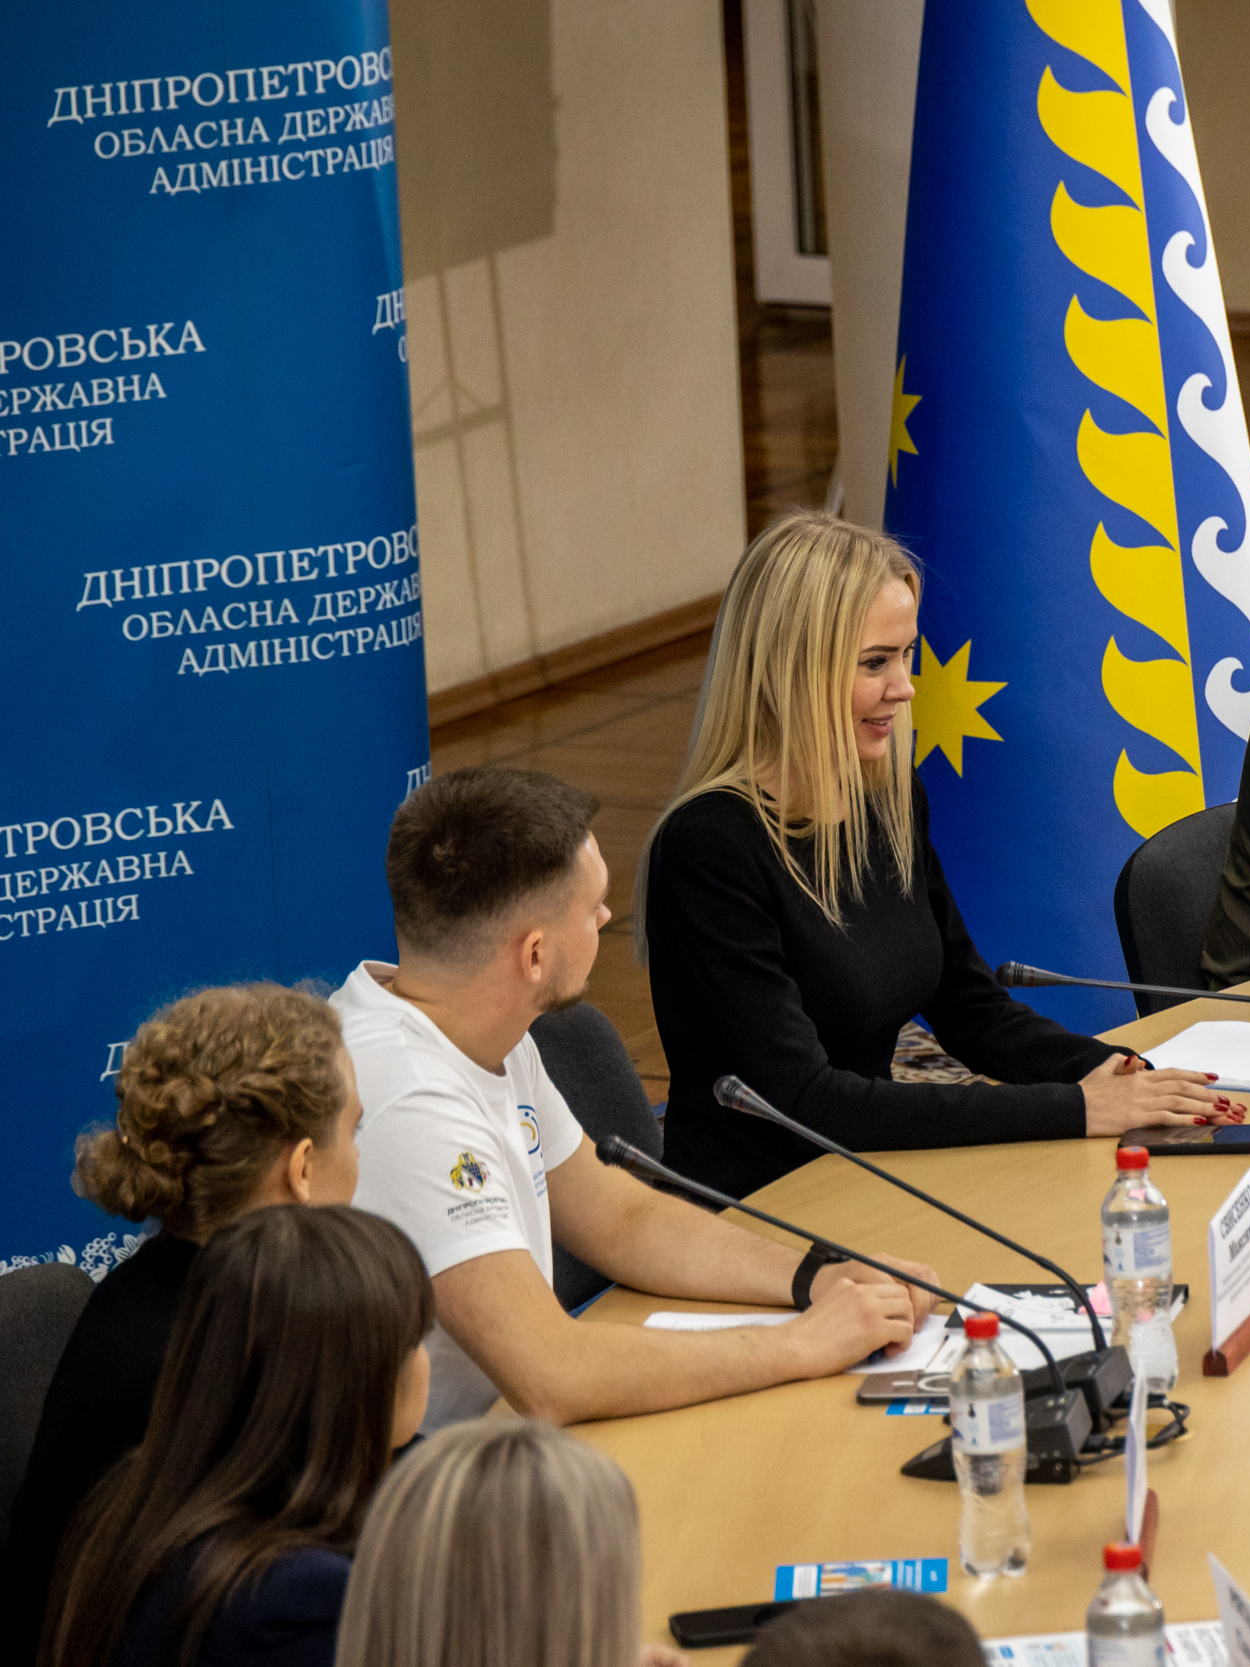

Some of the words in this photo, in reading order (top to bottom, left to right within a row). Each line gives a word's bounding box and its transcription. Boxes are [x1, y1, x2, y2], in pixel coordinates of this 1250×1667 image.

[94, 116, 270, 159] ОБЛАСНА
[149, 135, 394, 196] АДМІНІСТРАЦІЯ
[0, 417, 115, 456] РАЦІЯ
[122, 598, 300, 641] ОБЛАСНА
[177, 611, 424, 677] АДМІНІСТРАЦІЯ
